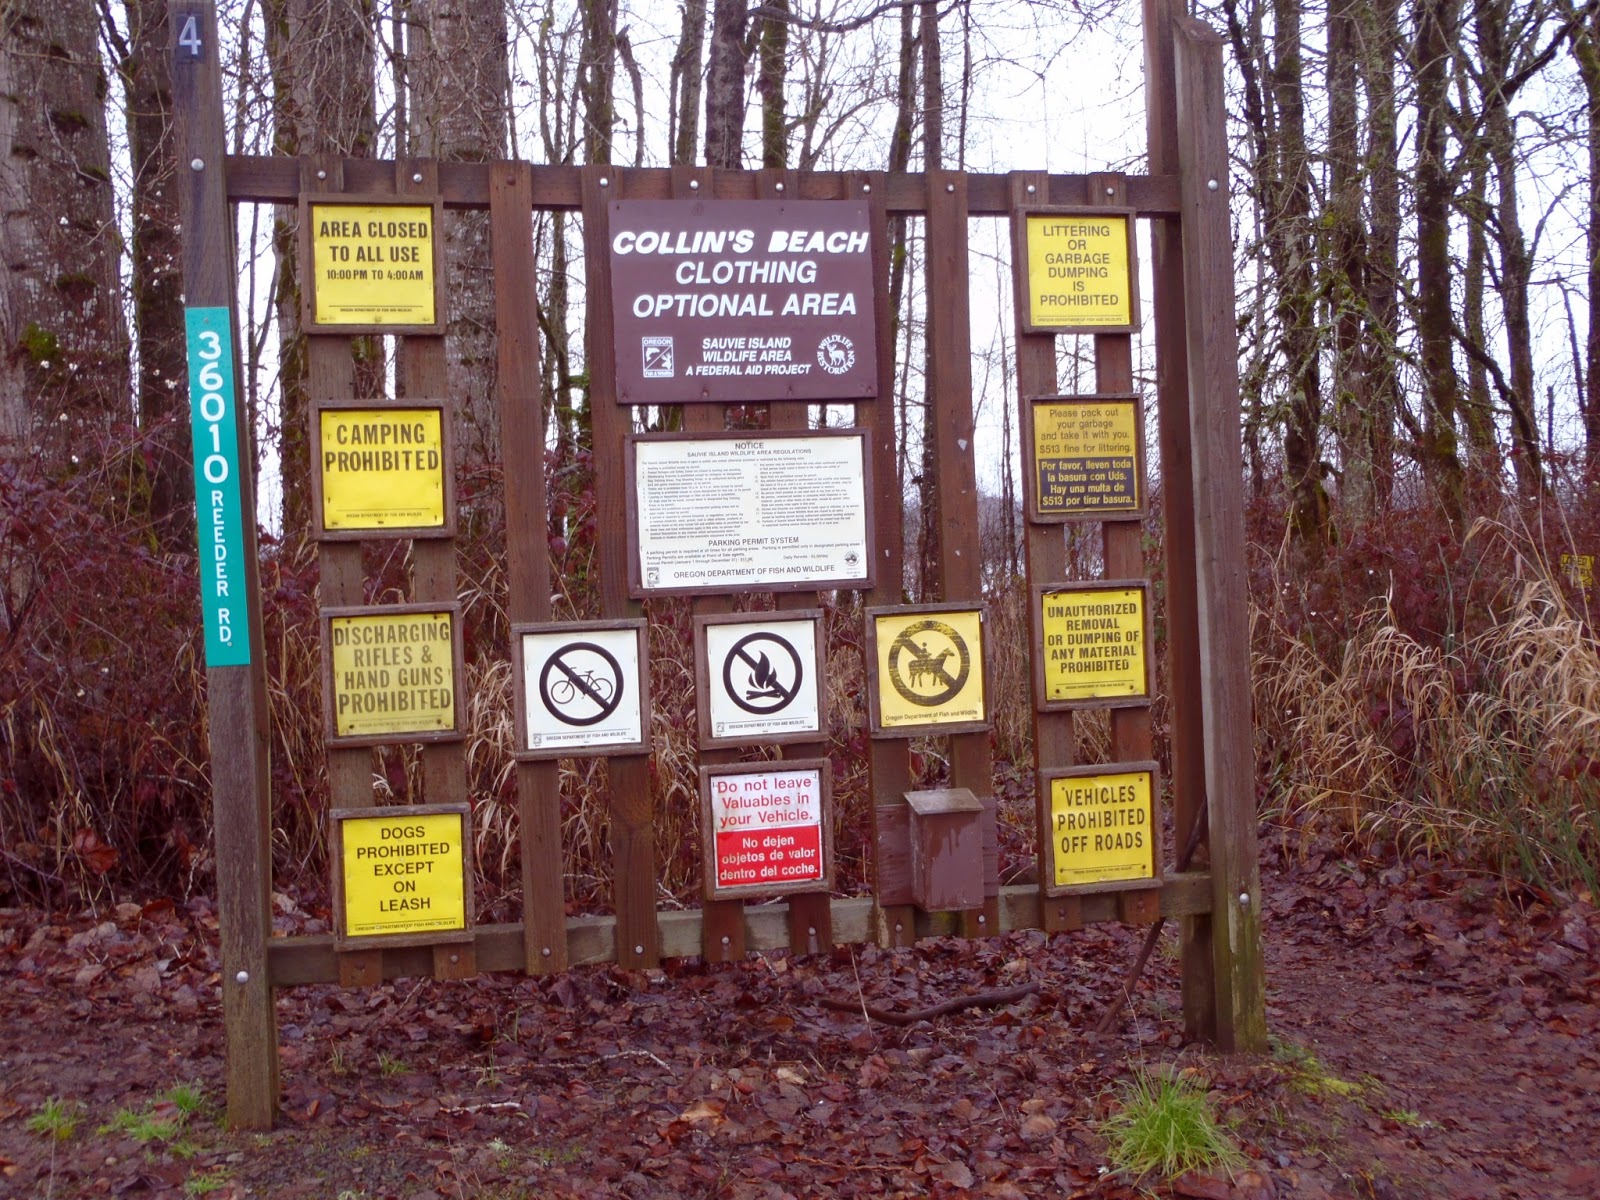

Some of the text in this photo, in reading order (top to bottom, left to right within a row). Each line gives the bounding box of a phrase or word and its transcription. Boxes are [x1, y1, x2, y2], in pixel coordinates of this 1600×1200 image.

[179, 16, 202, 54] 4
[320, 221, 428, 238] AREA CLOSED
[1043, 226, 1110, 237] LITTERING
[613, 230, 869, 254] COLLIN'S BEACH
[1068, 240, 1086, 251] OR
[329, 246, 420, 262] TO ALL USE
[1045, 253, 1110, 264] GARBAGE
[372, 270, 383, 280] TO
[675, 261, 817, 284] CLOTHING
[1049, 267, 1108, 278] DUMPING
[1073, 281, 1085, 292] IS
[633, 293, 857, 318] OPTIONAL AREA
[1040, 295, 1118, 306] PROHIBITED
[702, 337, 791, 349] SAUVIE ISLAND
[818, 334, 853, 350] WILDLIFE
[703, 350, 792, 362] WILDLIFE AREA
[817, 350, 855, 375] RESTORATION
[685, 364, 811, 376] A FEDERAL AID PROJECT
[1049, 409, 1078, 418] Please
[1081, 409, 1101, 418] pack
[1057, 420, 1113, 430] your garbage
[337, 423, 425, 445] CAMPING
[1041, 432, 1056, 440] and
[1061, 431, 1079, 439] take
[1083, 431, 1088, 439] it
[1113, 431, 1129, 440] you.
[735, 442, 764, 450] NOTICE
[1040, 445, 1060, 454] $513
[1084, 444, 1095, 452] for
[1099, 444, 1132, 452] littering.
[325, 450, 439, 472] PROHIBITED
[1041, 460, 1131, 471] Por favor, lleven toda
[1048, 471, 1126, 482] la basura con Uds.
[198, 331, 231, 642] 36010 REEDER RD
[1050, 485, 1066, 495] Hay
[1088, 484, 1110, 493] multa
[1114, 483, 1124, 492] de
[1042, 495, 1132, 506] $513 por tirar basura.
[708, 536, 799, 547] PARKING PERMIT SYSTEM
[708, 568, 755, 577] DEPARTMENT
[1048, 603, 1137, 618] UNAUTHORIZED
[1066, 618, 1120, 631] REMOVAL
[334, 622, 449, 646] DISCHARGING
[1048, 630, 1139, 646] OR DUMPING OF
[354, 645, 432, 668] RIFLES &
[1051, 645, 1137, 660] ANY MATERIAL
[1060, 660, 1129, 674] PROHIBITED
[345, 667, 443, 690] HAND GUNS
[339, 688, 451, 715] PROHIBITED
[718, 778, 811, 793] Do not leave
[722, 793, 809, 809] Valuables in
[1065, 785, 1135, 806] VEHICLES
[720, 809, 813, 828] your Vehicle.
[1058, 808, 1145, 831] PROHIBITED
[381, 826, 425, 840] DOGS
[742, 835, 794, 848] No dejen
[1061, 831, 1142, 853] OFF ROADS
[357, 842, 450, 859] PROHIBITED
[722, 847, 815, 865] objetos de valor
[374, 861, 434, 876] EXCEPT
[720, 863, 818, 880] dentro del coche.
[393, 880, 415, 893] ON
[380, 897, 430, 912] LEASH
